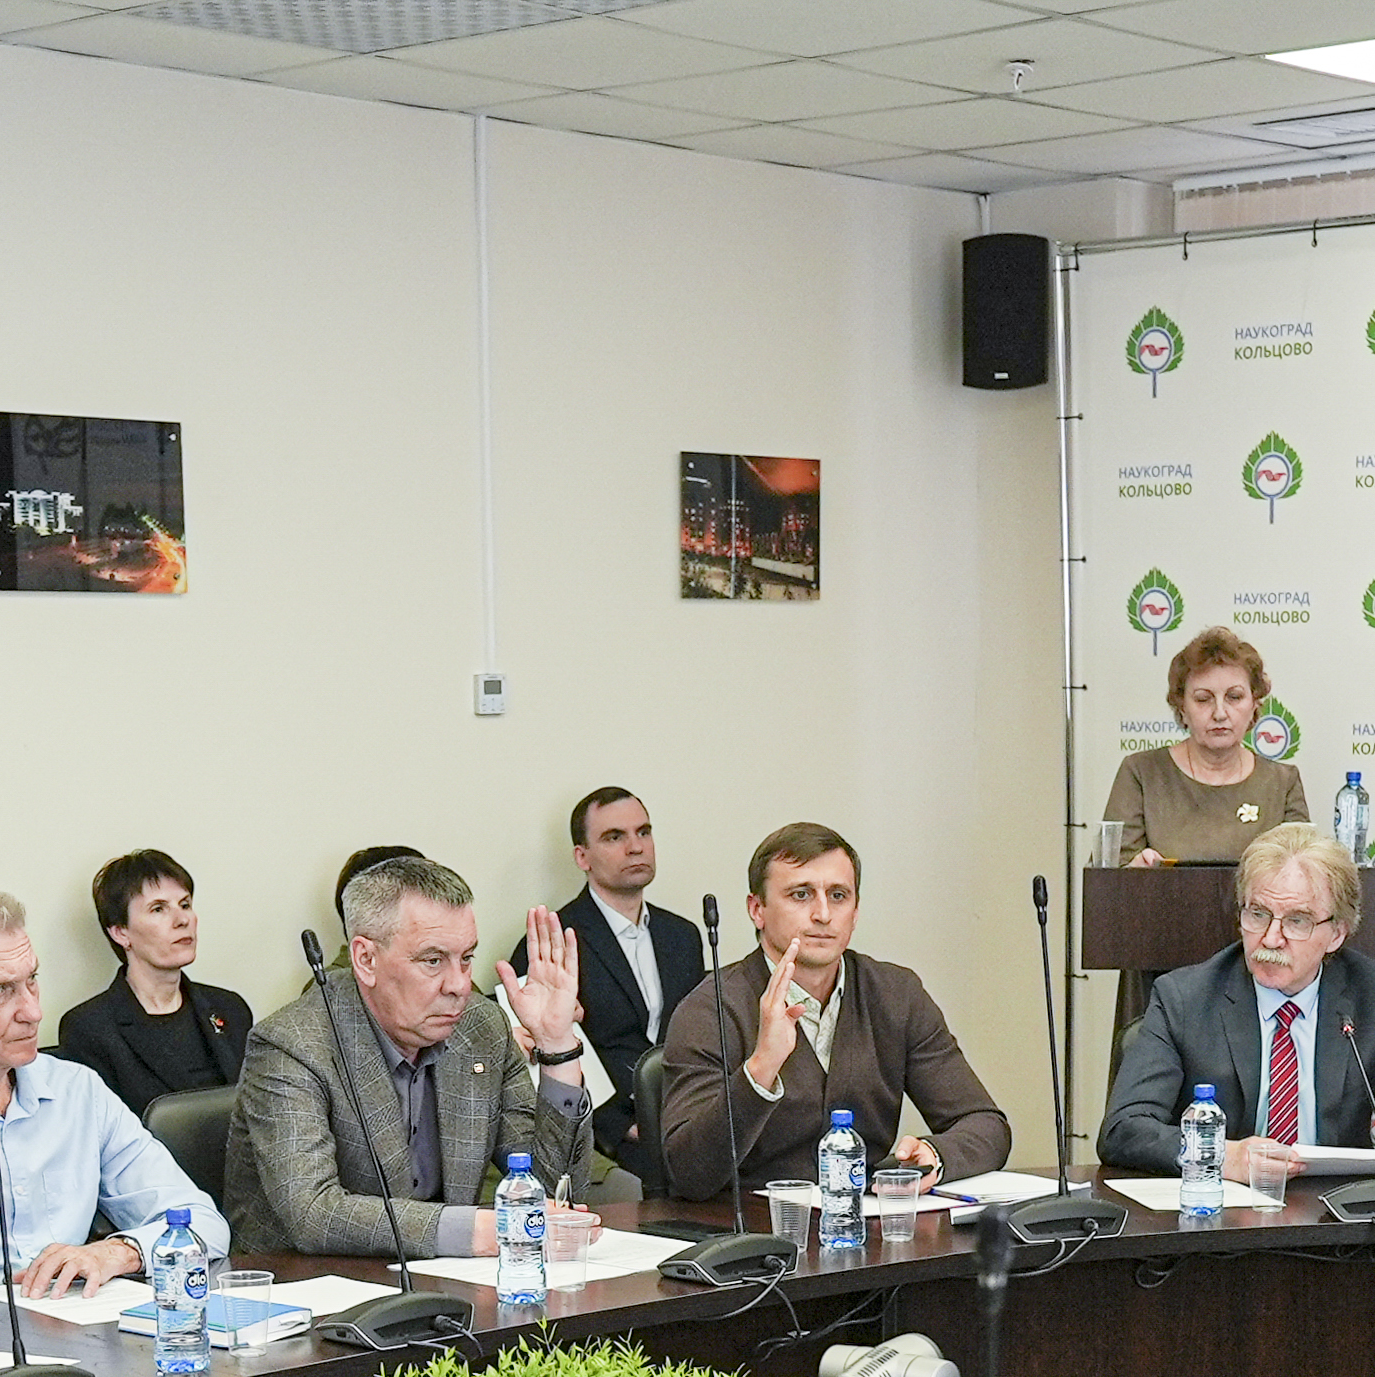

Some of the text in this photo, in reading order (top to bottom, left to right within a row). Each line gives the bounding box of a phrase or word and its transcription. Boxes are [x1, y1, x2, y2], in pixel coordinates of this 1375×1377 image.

[1234, 322, 1314, 340] НАУКОГРАД
[1234, 342, 1314, 361] КОЛЬЦОВО
[1118, 464, 1193, 479] НАУКОГРАД
[1118, 482, 1193, 499] КОЛЬЦОВО
[1233, 592, 1311, 607] НАУКОГРАД
[1233, 611, 1311, 626] КОЛЬЦОВО
